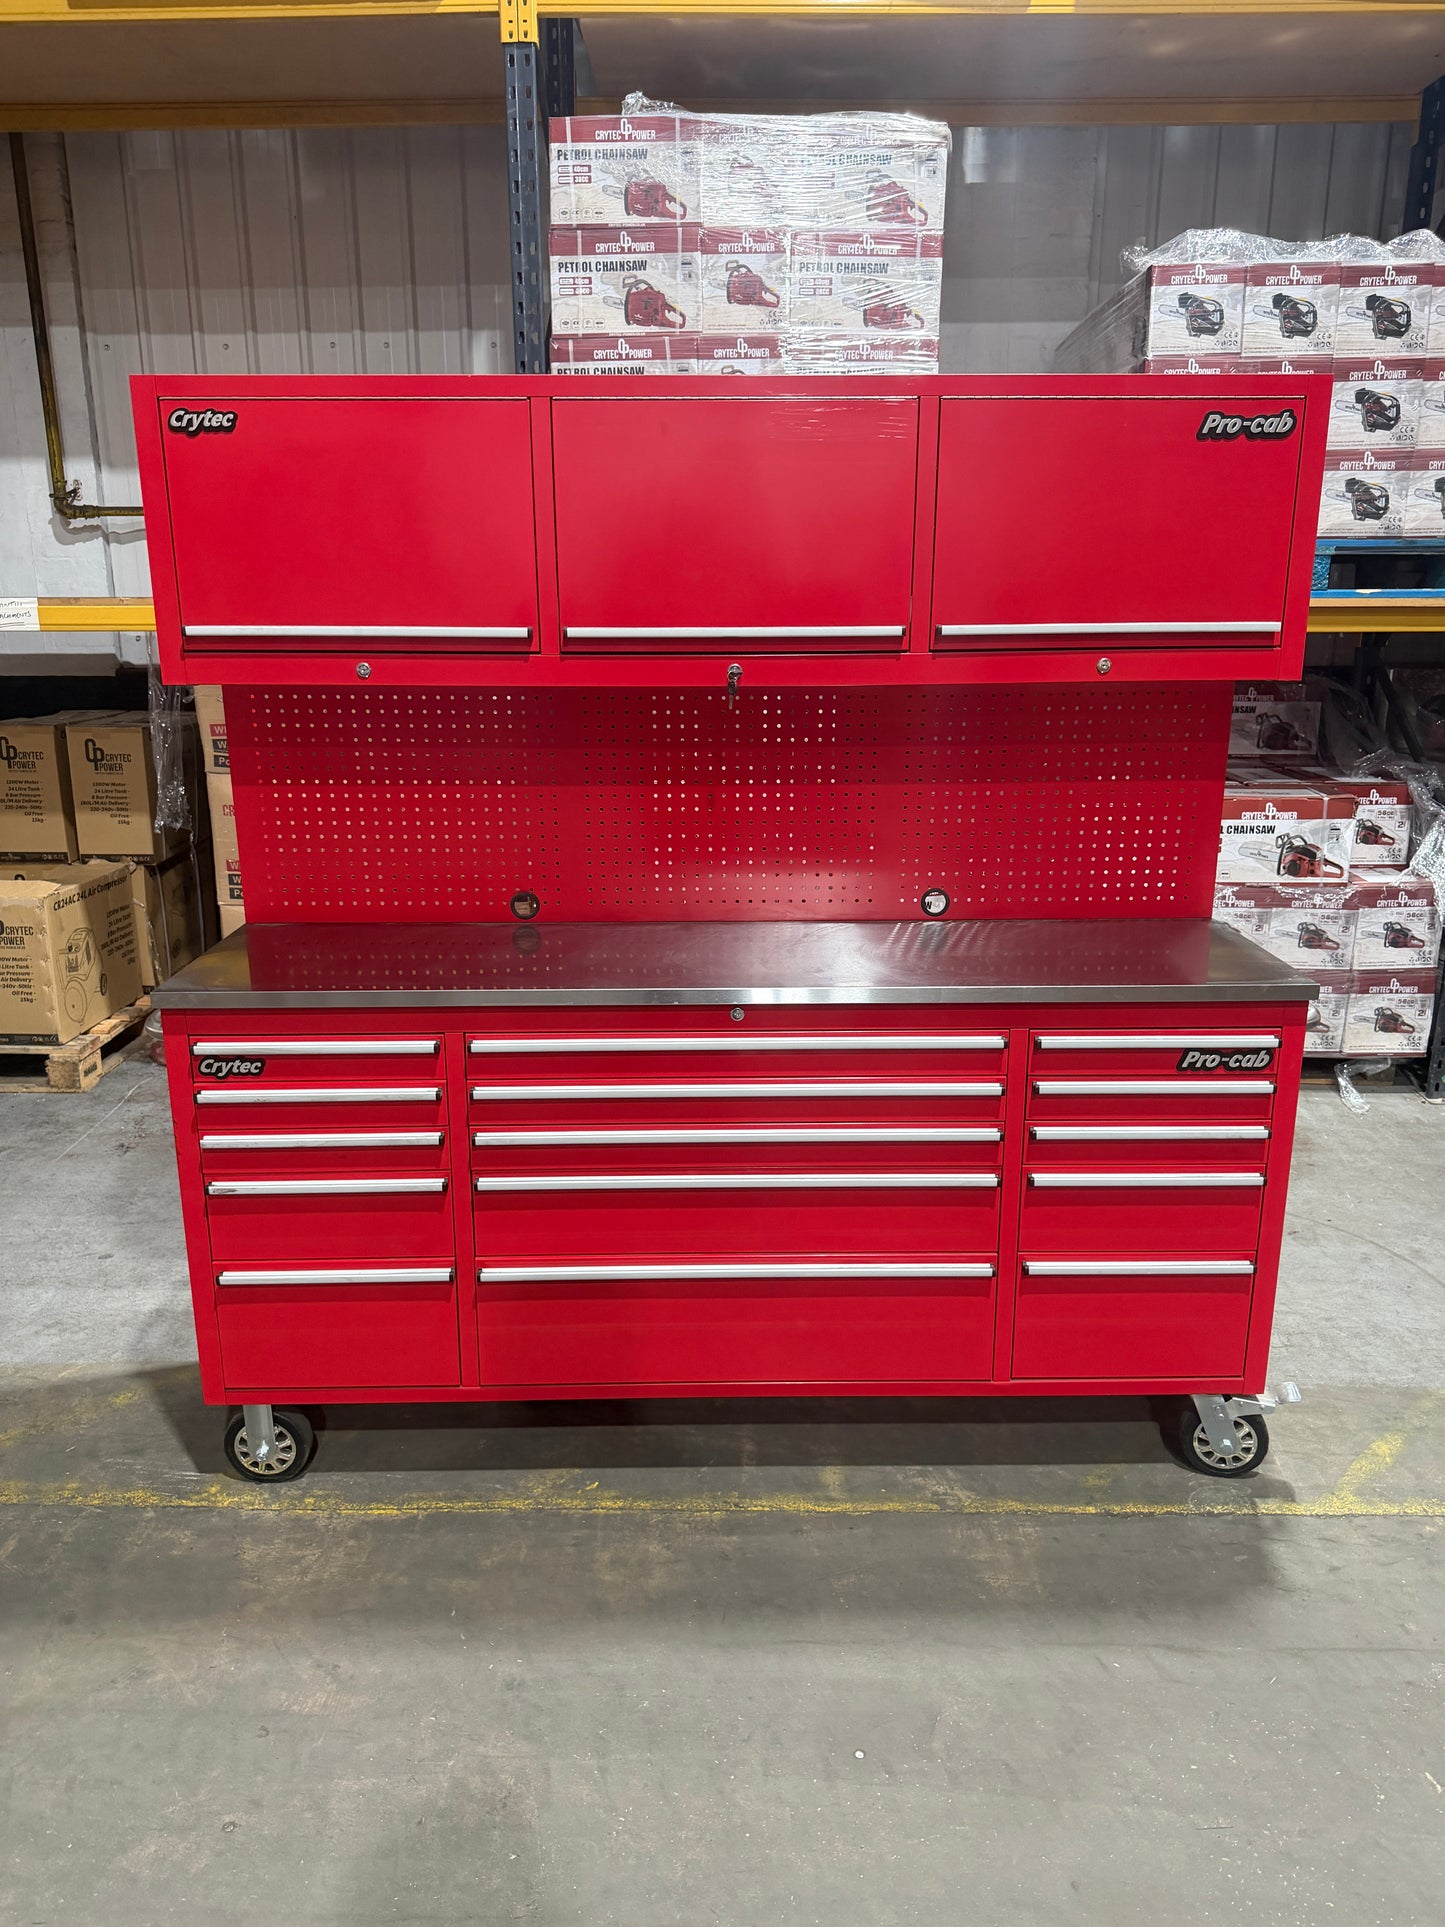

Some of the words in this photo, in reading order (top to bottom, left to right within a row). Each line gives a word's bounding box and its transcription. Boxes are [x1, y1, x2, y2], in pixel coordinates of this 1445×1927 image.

[595, 130, 621, 141] CRYTEC
[632, 130, 656, 140] POWER
[557, 149, 592, 160] PETROL
[595, 148, 648, 160] CHAINSAW
[596, 242, 620, 253] CRYTEC
[631, 242, 655, 252] POWER
[719, 243, 742, 252] CRYTEC
[753, 243, 775, 252] POWER
[595, 260, 647, 272] CHAINSAW
[800, 262, 834, 273] PETROL
[837, 262, 889, 274] CHAINSAW
[1171, 276, 1195, 285] CRYTEC
[1205, 274, 1228, 284] POWER
[1266, 276, 1290, 285] CRYTEC
[1300, 275, 1322, 284] POWER
[1360, 277, 1384, 286] CRYTEC
[1394, 276, 1417, 284] POWER
[594, 350, 618, 360] CRYTEC
[629, 349, 652, 358] POWER
[714, 349, 737, 358] CRYTEC
[747, 348, 769, 357] POWER
[870, 350, 893, 360] POWER
[1349, 371, 1374, 380] CRYTEC
[1384, 370, 1406, 379] POWER
[170, 410, 234, 431] Crytec
[1202, 412, 1293, 434] Pro-cab
[1340, 461, 1363, 470] CRYTEC
[1373, 461, 1395, 470] POWER
[18, 752, 44, 760] CRYTEC
[105, 754, 132, 762] CRYTEC
[12, 761, 36, 769] POWER
[100, 763, 124, 771] POWER
[1227, 825, 1276, 834] CHAINSAW
[54, 894, 76, 911] CR24AC
[5, 926, 34, 936] CRYTEC
[1182, 1050, 1270, 1068] Pro-cab
[200, 1059, 261, 1076] Crytec
